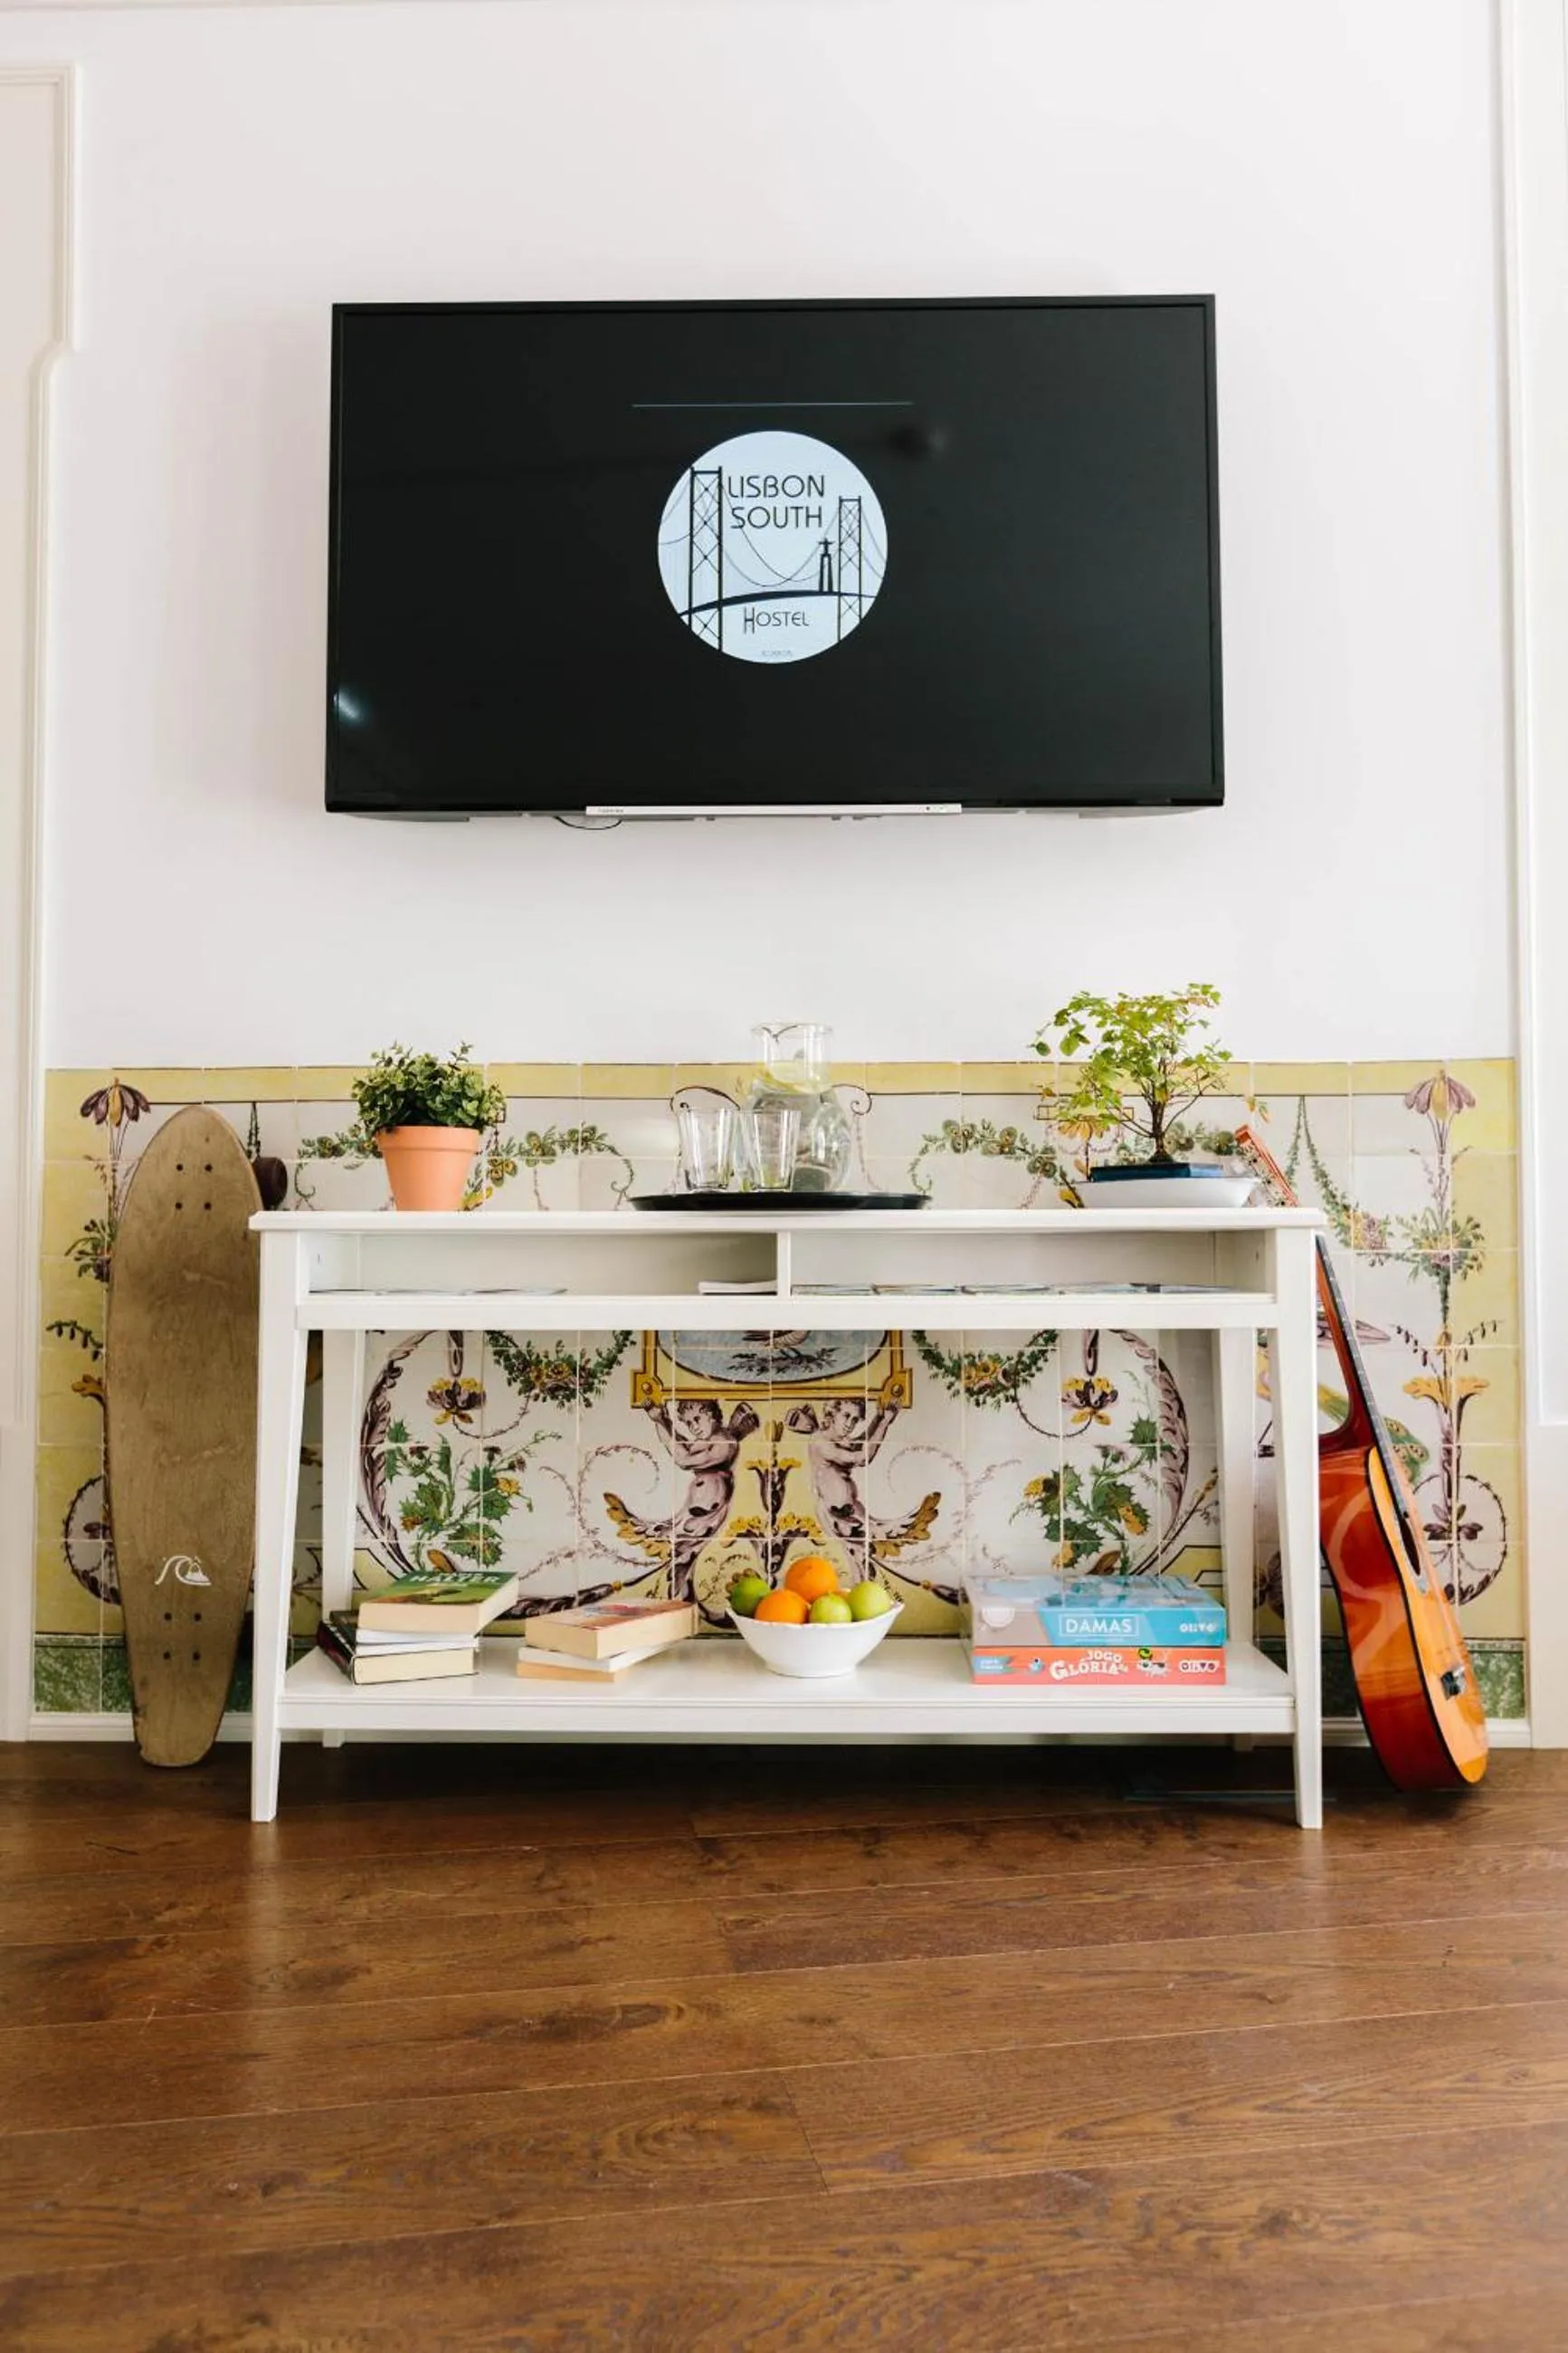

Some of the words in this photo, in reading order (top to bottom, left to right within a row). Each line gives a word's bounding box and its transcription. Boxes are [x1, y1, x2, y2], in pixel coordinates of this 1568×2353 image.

[727, 475, 824, 498] LISBON
[730, 506, 822, 529] SOUTH
[1066, 1618, 1132, 1634] DAMAS
[1086, 1650, 1122, 1663] JOGO
